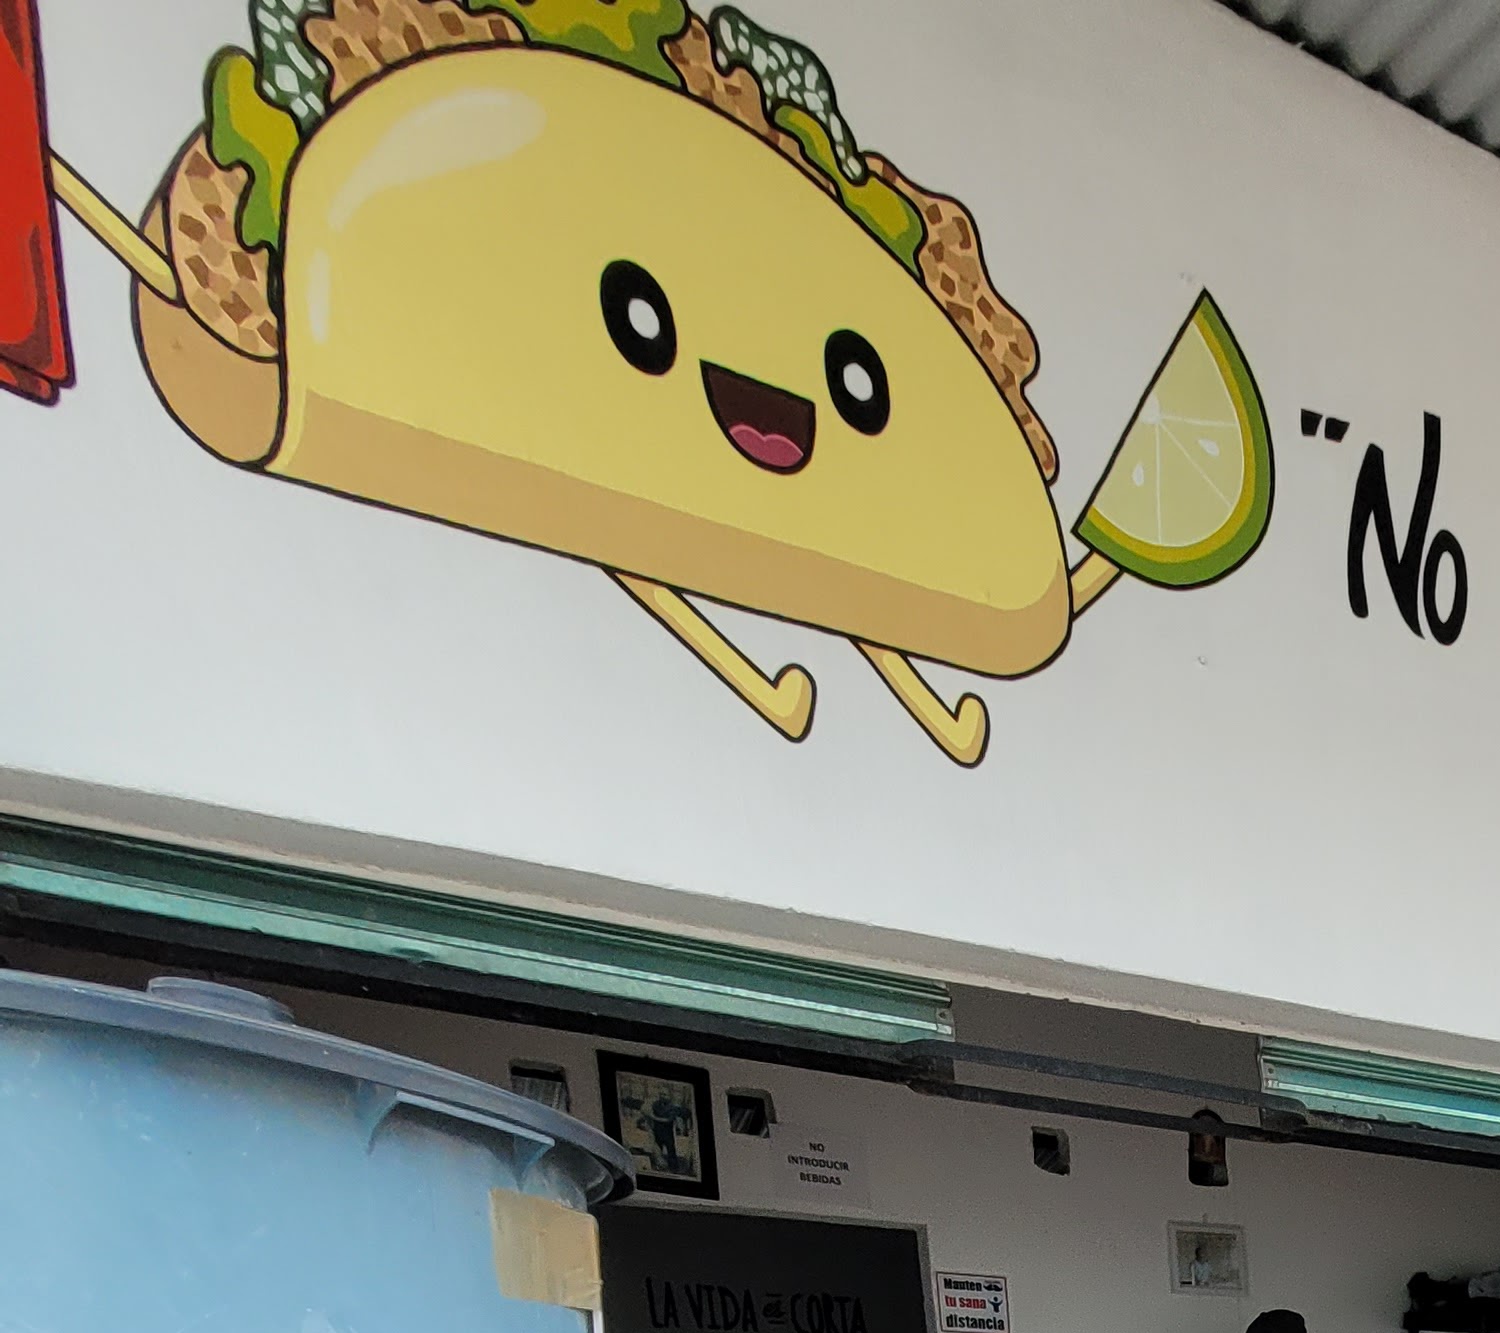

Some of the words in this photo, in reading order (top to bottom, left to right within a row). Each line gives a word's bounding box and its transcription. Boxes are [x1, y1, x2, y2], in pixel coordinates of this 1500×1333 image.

[808, 1141, 826, 1153] NO
[787, 1154, 851, 1172] INTRODUCIR
[799, 1171, 843, 1186] BEBIDAS
[645, 1276, 681, 1329] LA
[683, 1283, 760, 1333] VIDA
[944, 1294, 957, 1308] tu
[958, 1296, 987, 1310] sana
[945, 1313, 1006, 1331] distancia
